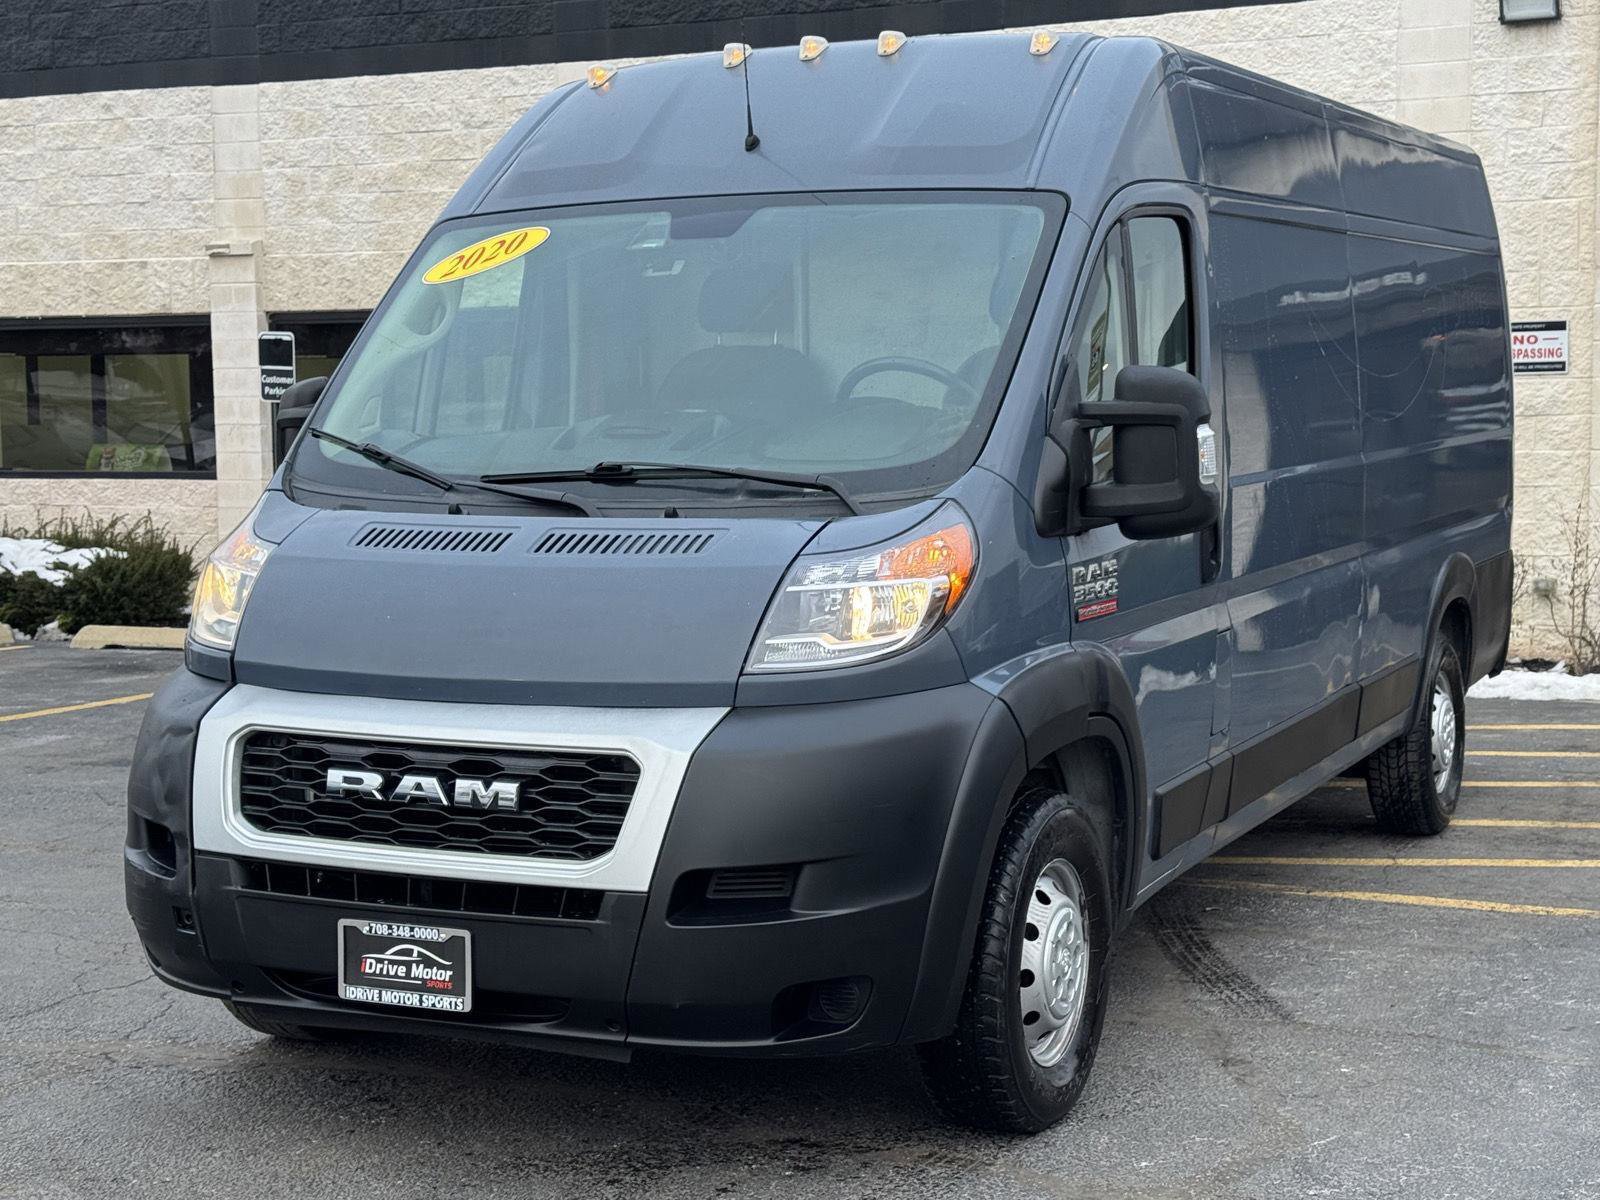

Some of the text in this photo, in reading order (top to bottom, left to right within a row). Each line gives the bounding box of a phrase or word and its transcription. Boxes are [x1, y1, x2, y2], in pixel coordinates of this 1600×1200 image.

[439, 231, 528, 280] 2020
[1513, 334, 1538, 345] NO
[261, 374, 293, 385] Customer
[1071, 559, 1118, 585] RAM
[325, 768, 522, 811] RAM
[369, 923, 439, 940] 708-348-0000
[360, 958, 453, 982] iDrive Motor
[425, 980, 453, 990] SPORTS
[381, 990, 420, 1006] MOTOR
[421, 995, 464, 1011] SPORTS
